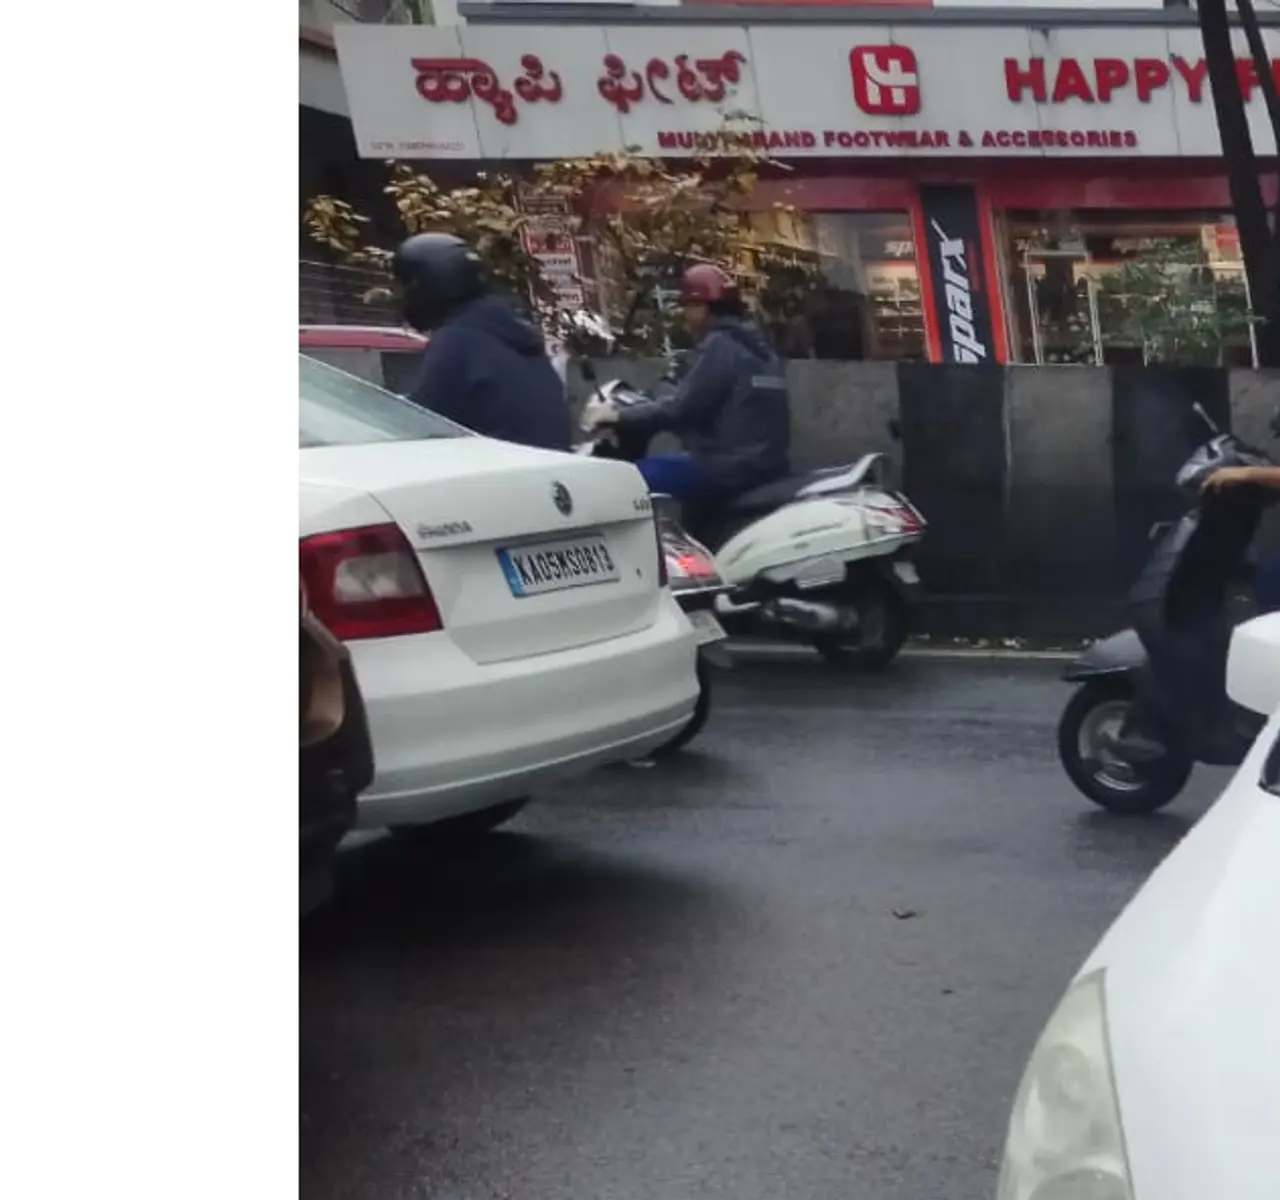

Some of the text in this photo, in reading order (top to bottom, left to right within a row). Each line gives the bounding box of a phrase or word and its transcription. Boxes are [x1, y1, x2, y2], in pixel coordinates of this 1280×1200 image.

[1003, 58, 1207, 102] HAPPY
[823, 130, 950, 148] FOOTWEAR
[981, 130, 1137, 148] ACCESSORIES
